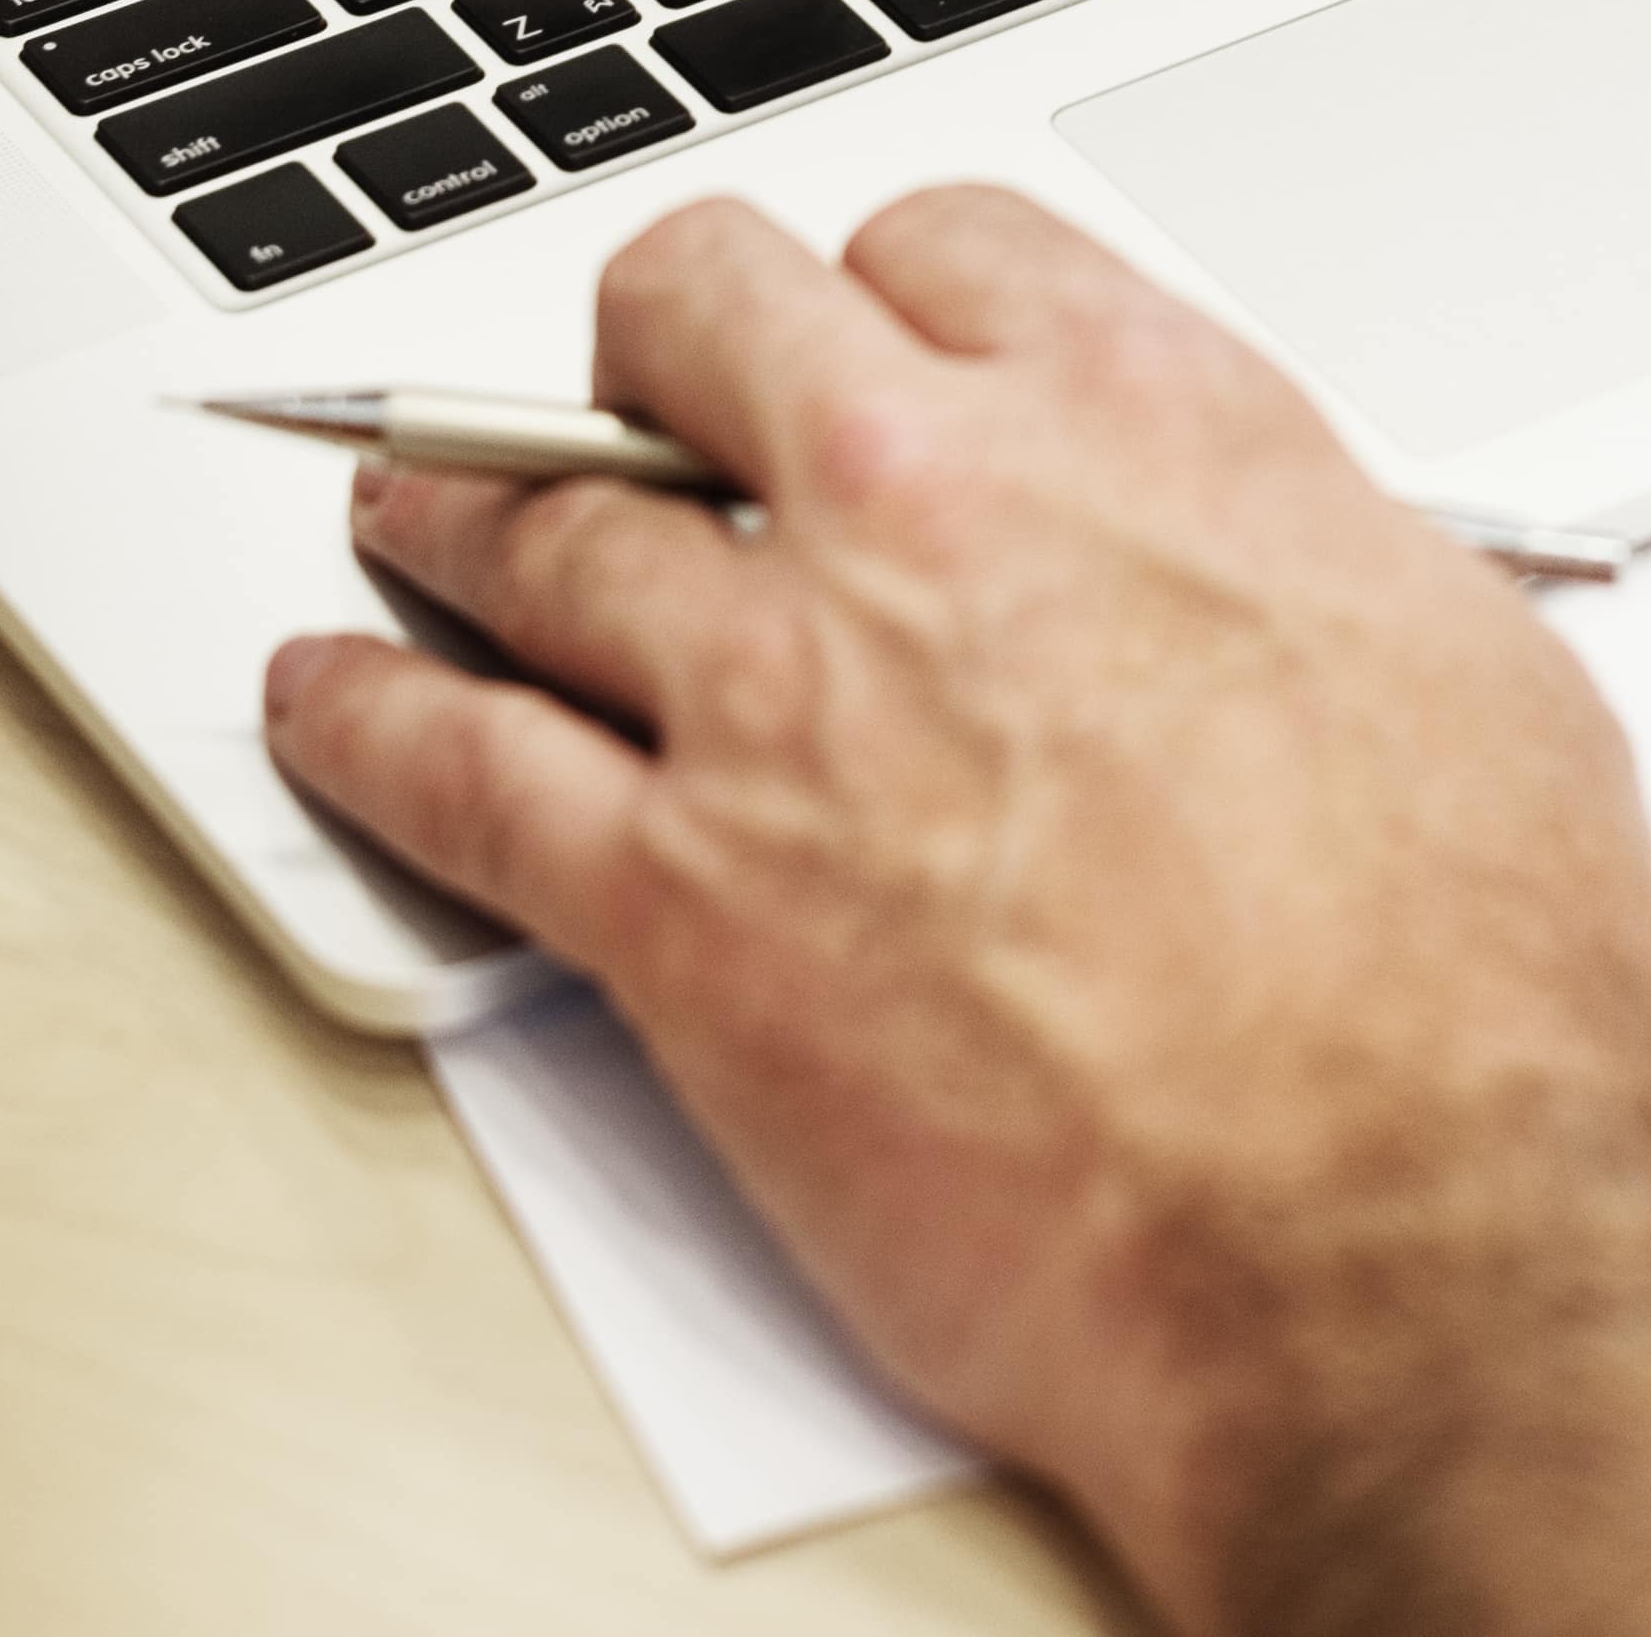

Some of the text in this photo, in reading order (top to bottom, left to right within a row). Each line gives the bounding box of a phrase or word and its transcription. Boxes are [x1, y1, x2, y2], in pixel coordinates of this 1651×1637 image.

[501, 14, 543, 41] Z
[85, 35, 212, 87] caps lock
[519, 83, 549, 102] alt
[563, 107, 653, 148] option
[160, 136, 221, 168] shift
[402, 159, 501, 208] control
[249, 244, 284, 263] fn
